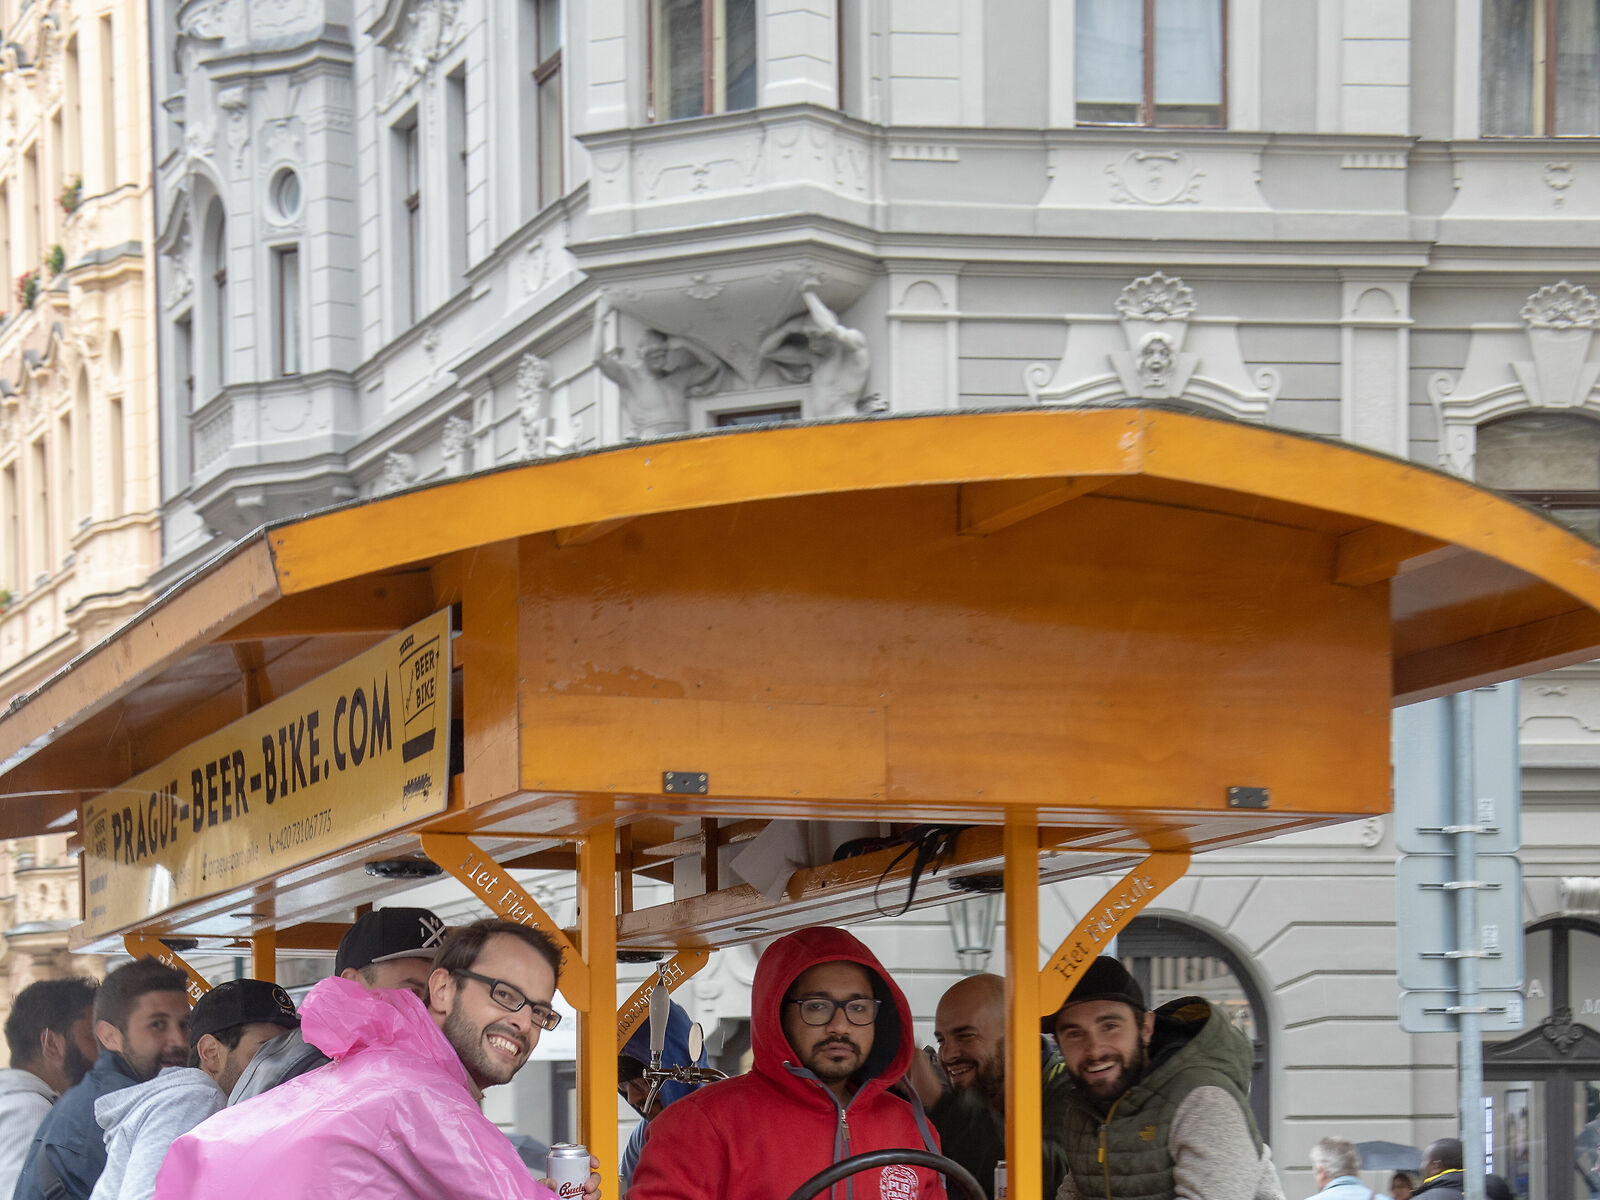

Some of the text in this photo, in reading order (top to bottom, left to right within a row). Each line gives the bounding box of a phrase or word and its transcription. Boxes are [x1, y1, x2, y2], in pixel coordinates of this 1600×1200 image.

[415, 649, 435, 681] BEER
[416, 677, 435, 708] BIKE
[112, 671, 392, 869] PRAGUE-BEER-BIKE.COM
[460, 853, 499, 894] Het
[1053, 942, 1089, 981] Het
